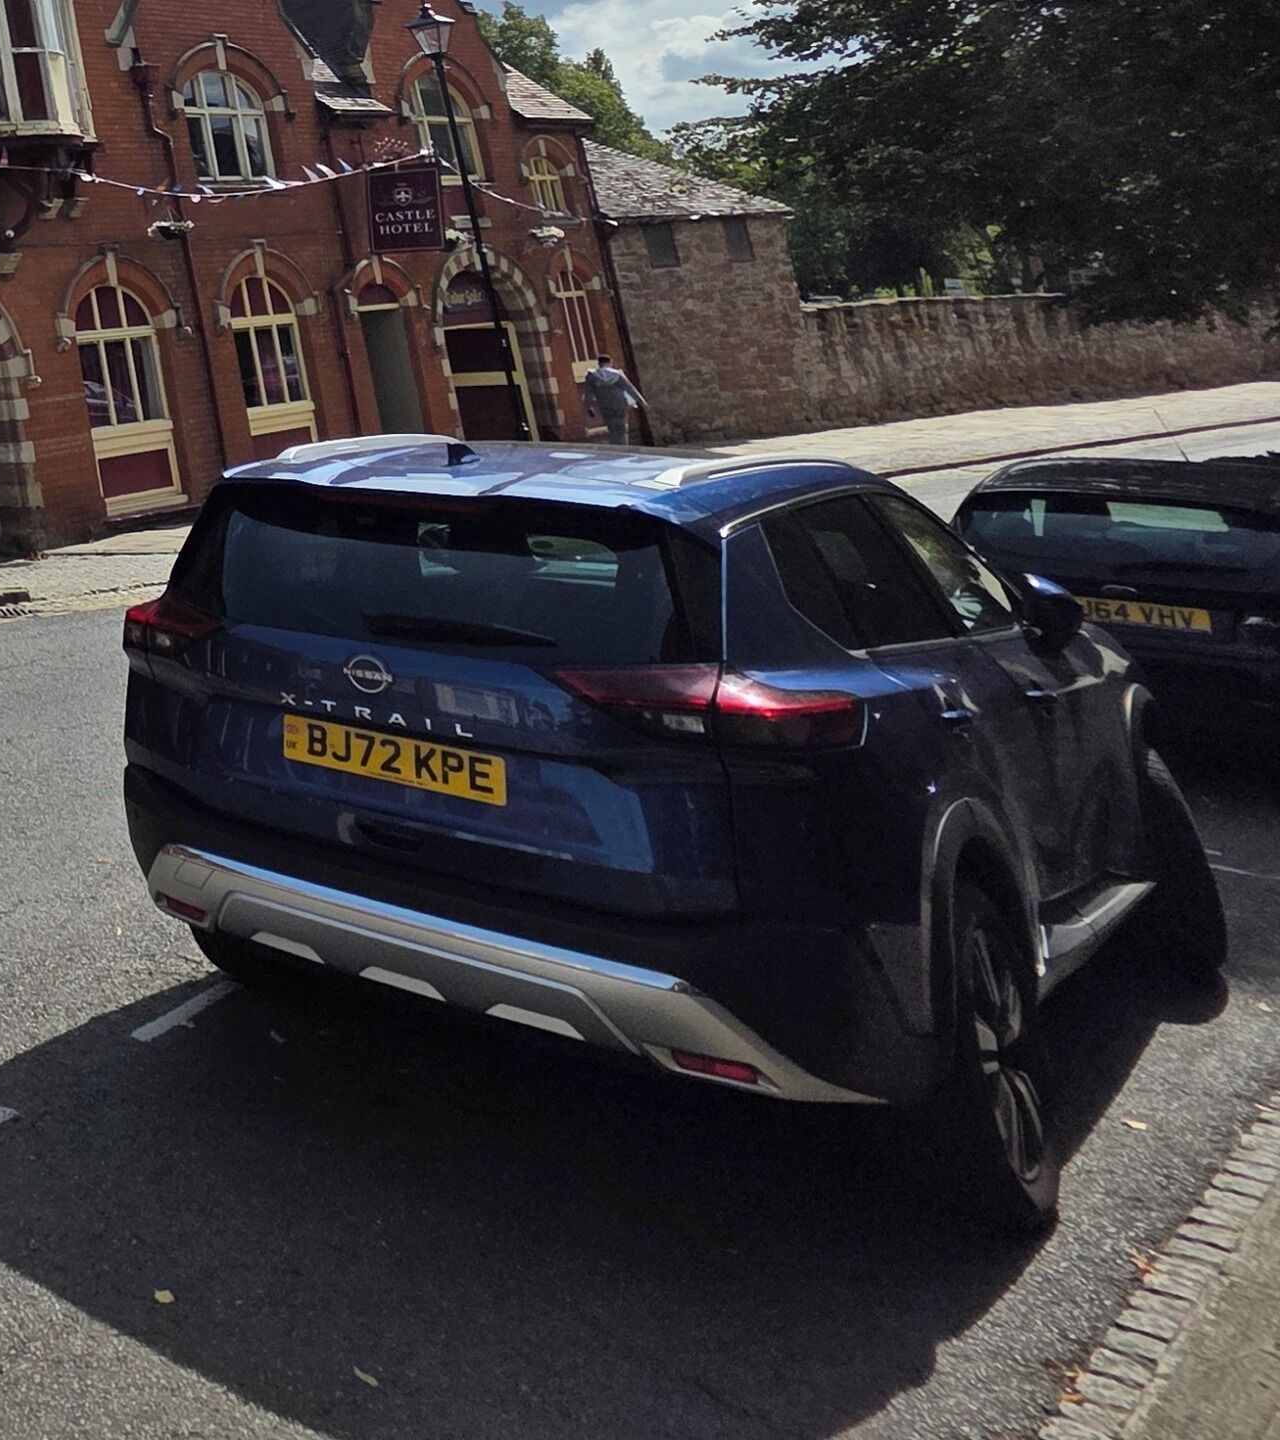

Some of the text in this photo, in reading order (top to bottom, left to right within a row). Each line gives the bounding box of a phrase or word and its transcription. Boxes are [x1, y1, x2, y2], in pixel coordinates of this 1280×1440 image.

[375, 209, 436, 223] CASTLE
[380, 222, 433, 236] HOTEL
[1140, 607, 1195, 627] VHV
[343, 667, 393, 682] NISSAN
[280, 691, 474, 738] X-TRAIL
[286, 740, 297, 750] UK
[307, 723, 495, 795] BJ72 KPE
